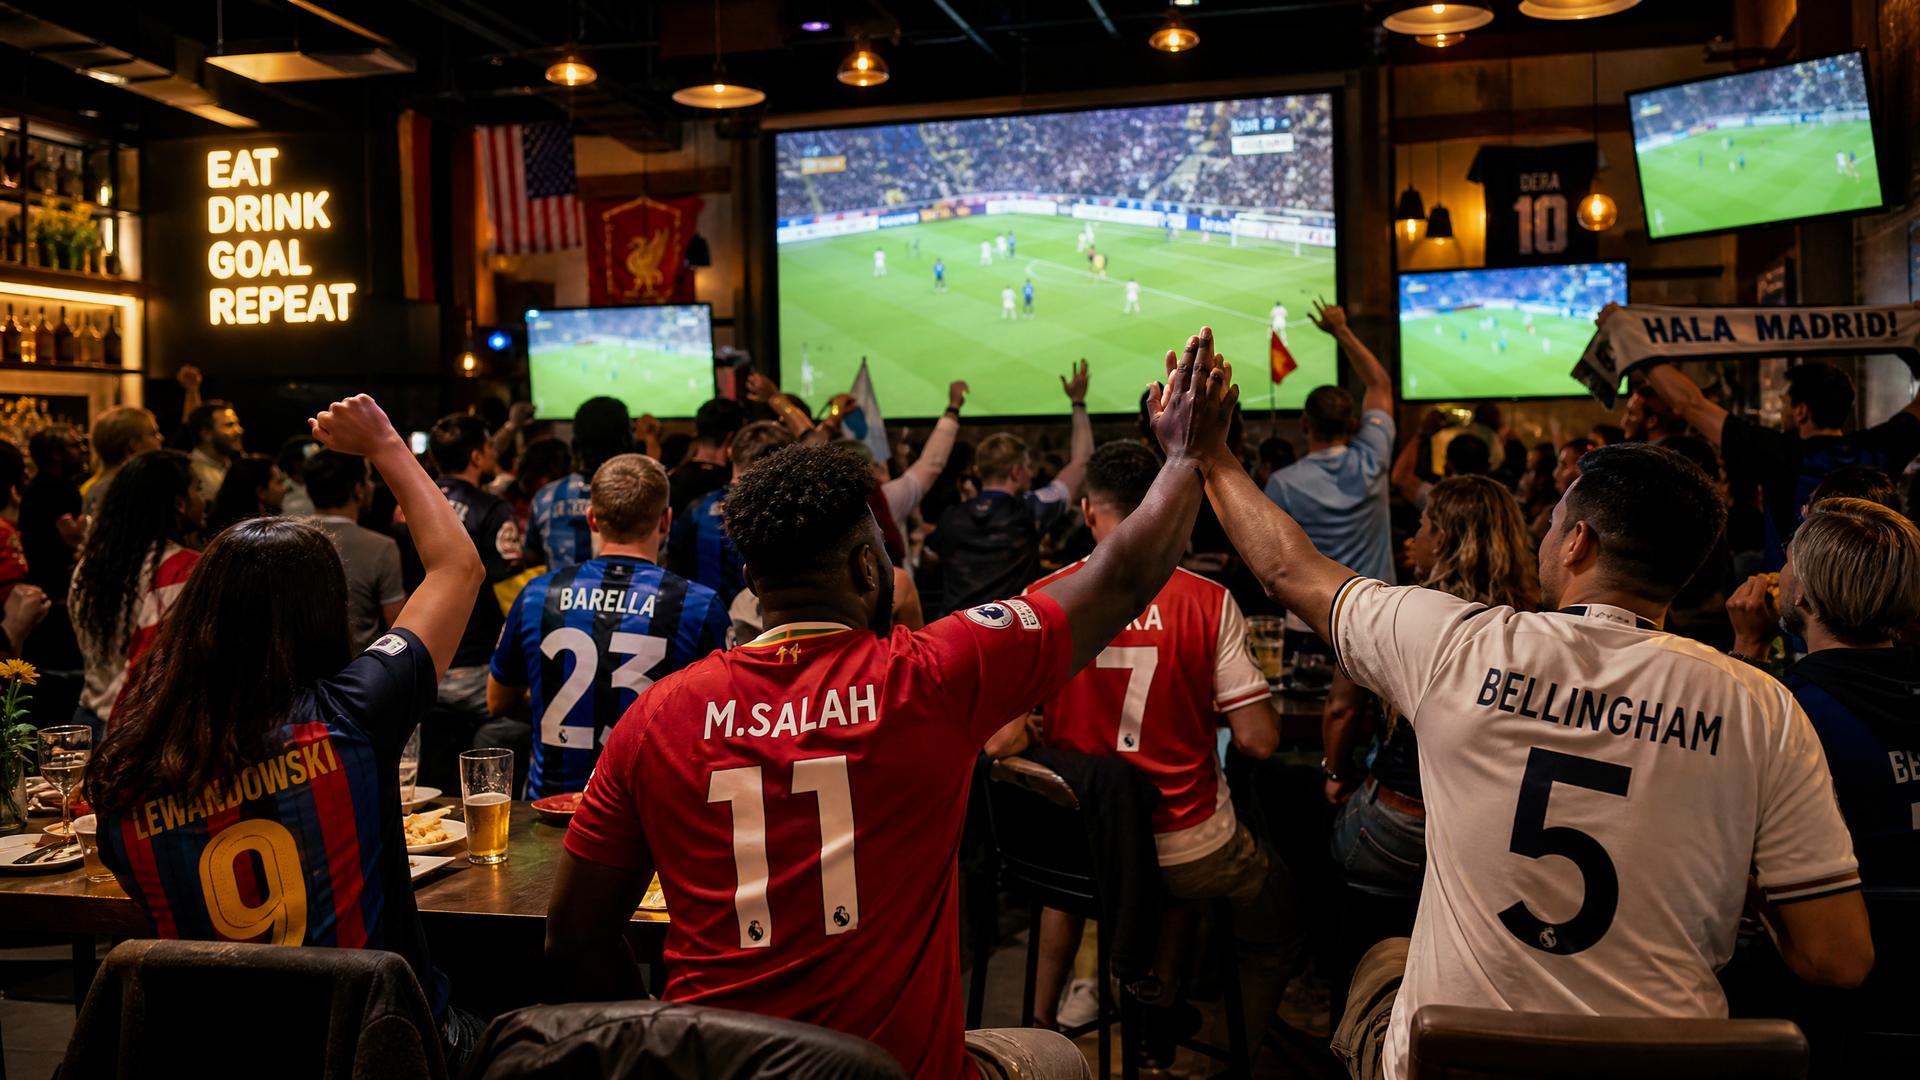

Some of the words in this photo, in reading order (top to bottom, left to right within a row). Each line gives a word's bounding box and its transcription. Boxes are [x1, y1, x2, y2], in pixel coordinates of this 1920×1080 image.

[207, 147, 279, 189] EAT
[208, 190, 331, 234] DRINK
[1513, 194, 1568, 254] 10
[208, 238, 312, 279] GOAL
[209, 282, 357, 326] REPEAT
[1642, 314, 1737, 344] HALA
[1754, 311, 1898, 342] MADRID!
[559, 587, 656, 618] BARELLA
[540, 626, 668, 750] 23
[703, 684, 877, 740] M.SALAH
[1096, 646, 1159, 752] 7
[1476, 667, 1723, 756] BELLINGHAM
[707, 754, 859, 949] 11
[1497, 746, 1632, 956] 5
[199, 818, 308, 948] 9
